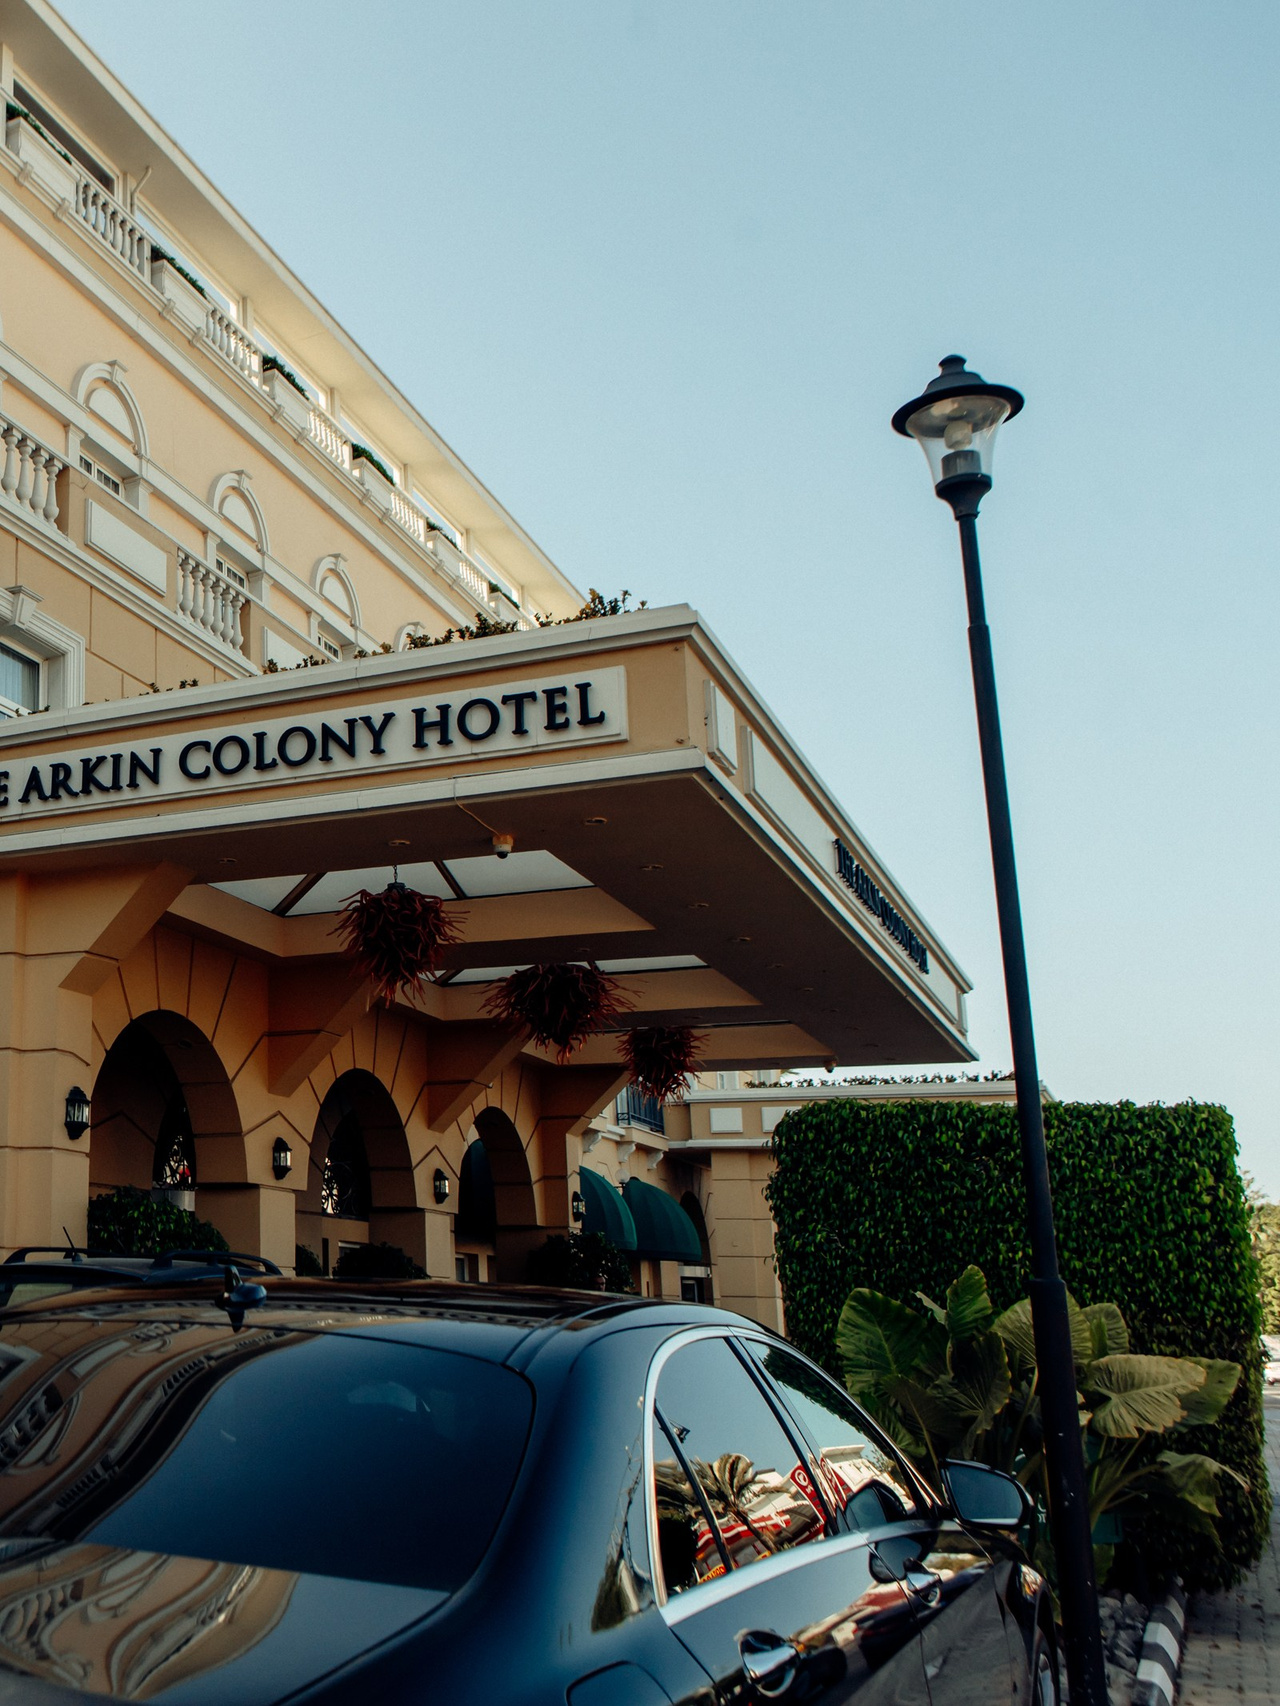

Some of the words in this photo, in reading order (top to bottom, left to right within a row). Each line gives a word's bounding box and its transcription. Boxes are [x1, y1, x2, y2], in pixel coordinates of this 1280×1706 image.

[18, 748, 163, 805] ARKIN
[178, 712, 396, 782] COLONY
[411, 682, 606, 750] HOTEL
